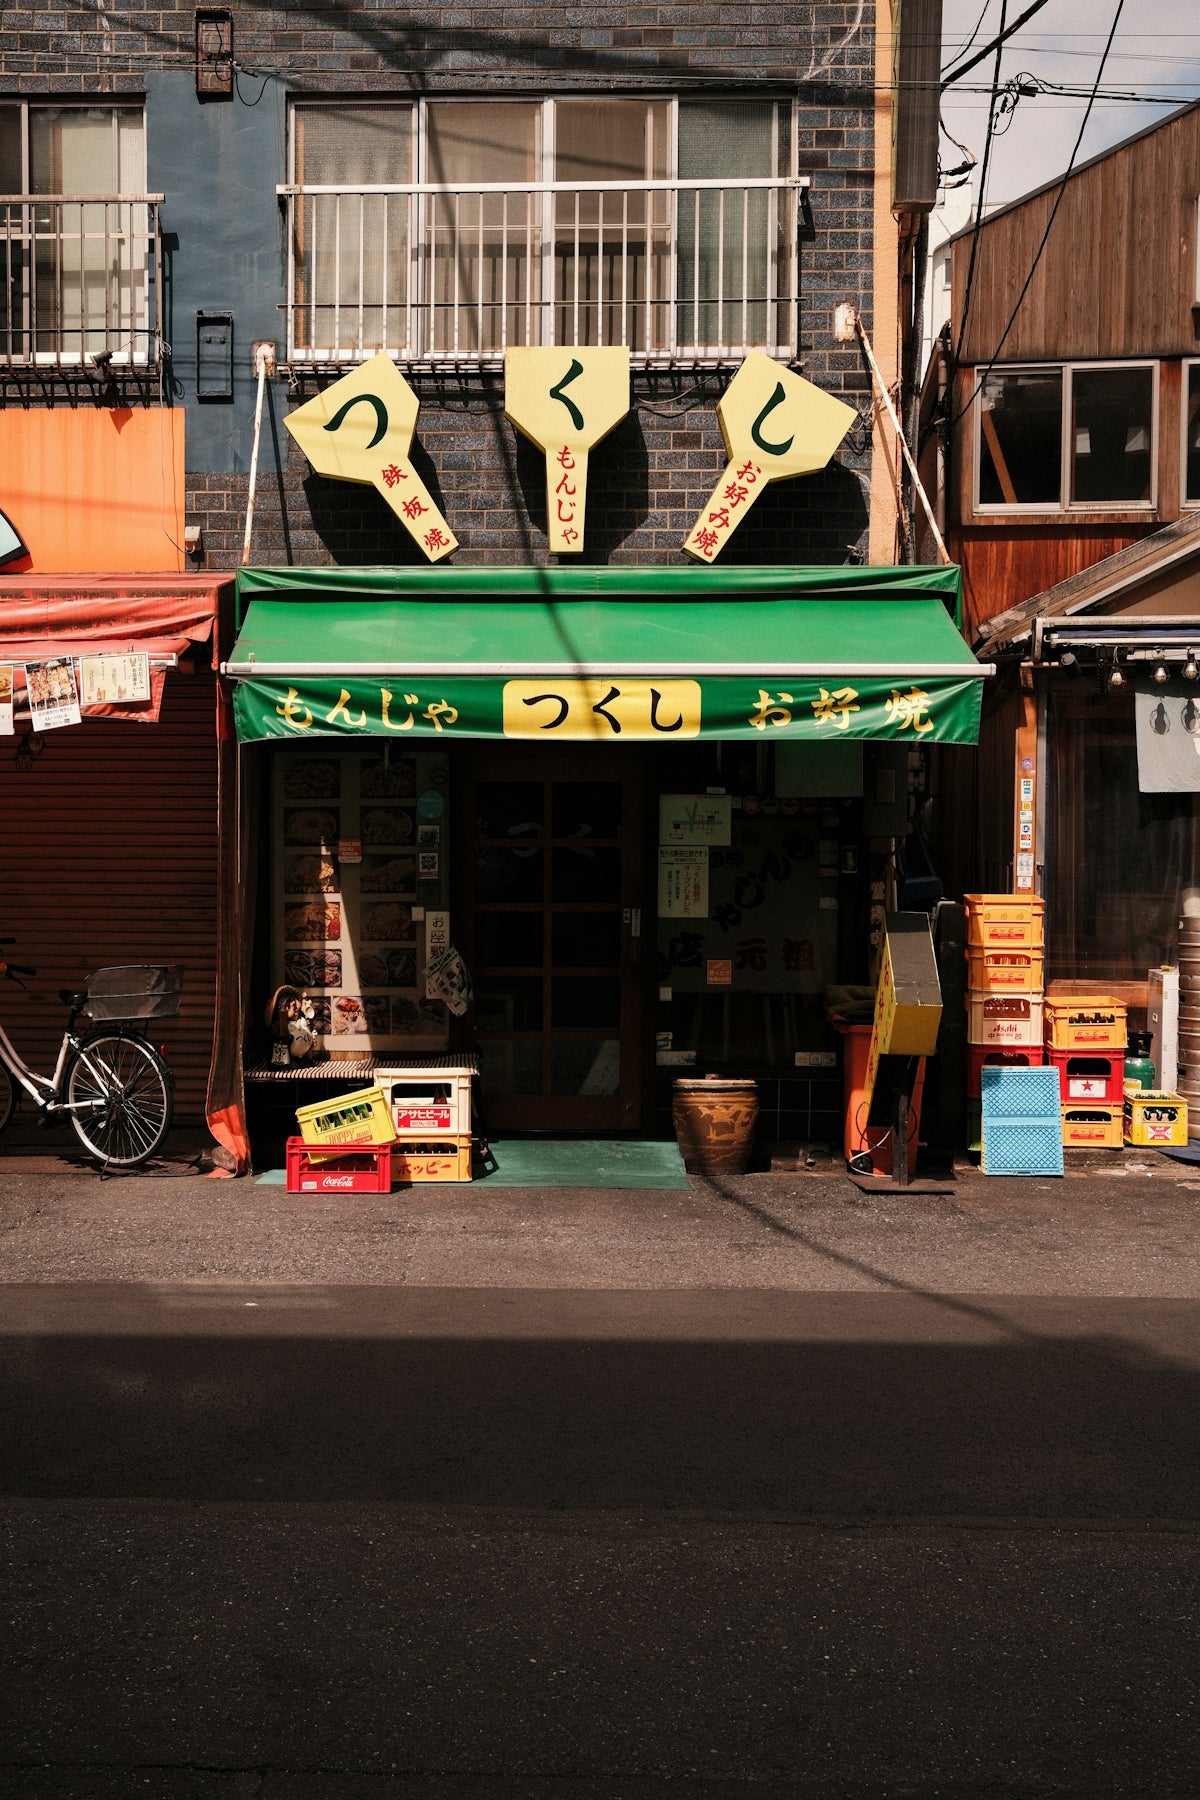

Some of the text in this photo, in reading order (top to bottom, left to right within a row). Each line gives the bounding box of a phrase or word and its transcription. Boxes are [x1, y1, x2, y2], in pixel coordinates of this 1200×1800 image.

[323, 394, 388, 449] つ
[549, 358, 584, 430] く
[752, 381, 794, 455] し
[381, 464, 450, 552] 鉄板焼
[555, 445, 578, 544] もんじゃ
[692, 460, 762, 557] お好み焼
[276, 686, 933, 734] もんじゃ つくし お好焼
[993, 1024, 1017, 1032] Asahi
[398, 1109, 450, 1119] アサヒビール
[322, 1175, 355, 1187] Coca-Cola
[397, 1160, 452, 1175] ホッピー
